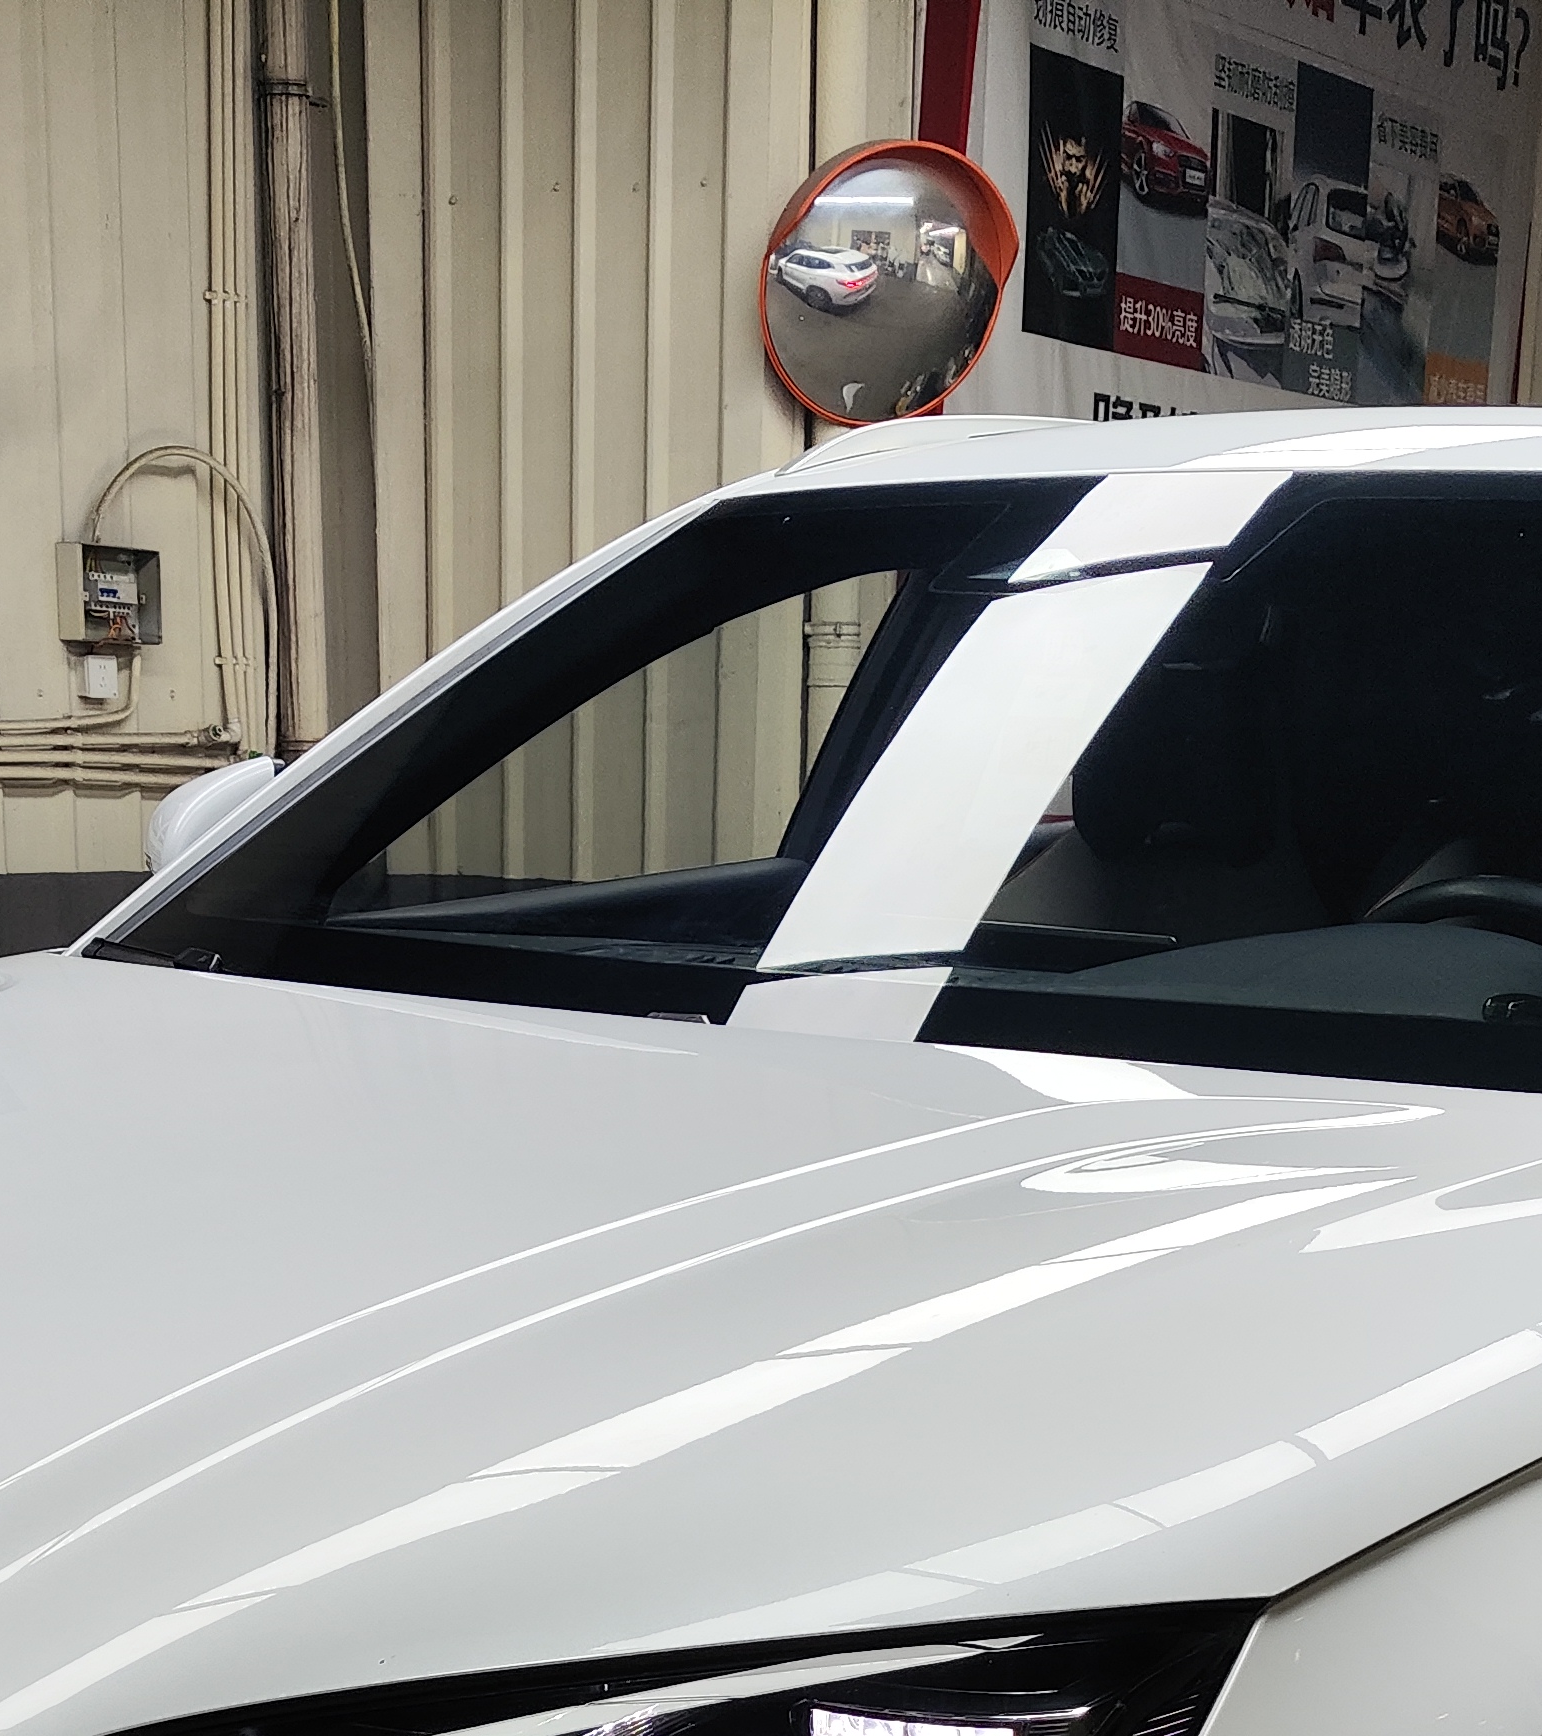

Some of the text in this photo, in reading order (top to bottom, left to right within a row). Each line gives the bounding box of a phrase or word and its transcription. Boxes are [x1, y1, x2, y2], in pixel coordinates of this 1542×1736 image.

[1119, 295, 1199, 349] 提升30%亮度
[1289, 318, 1334, 359] 透明无色
